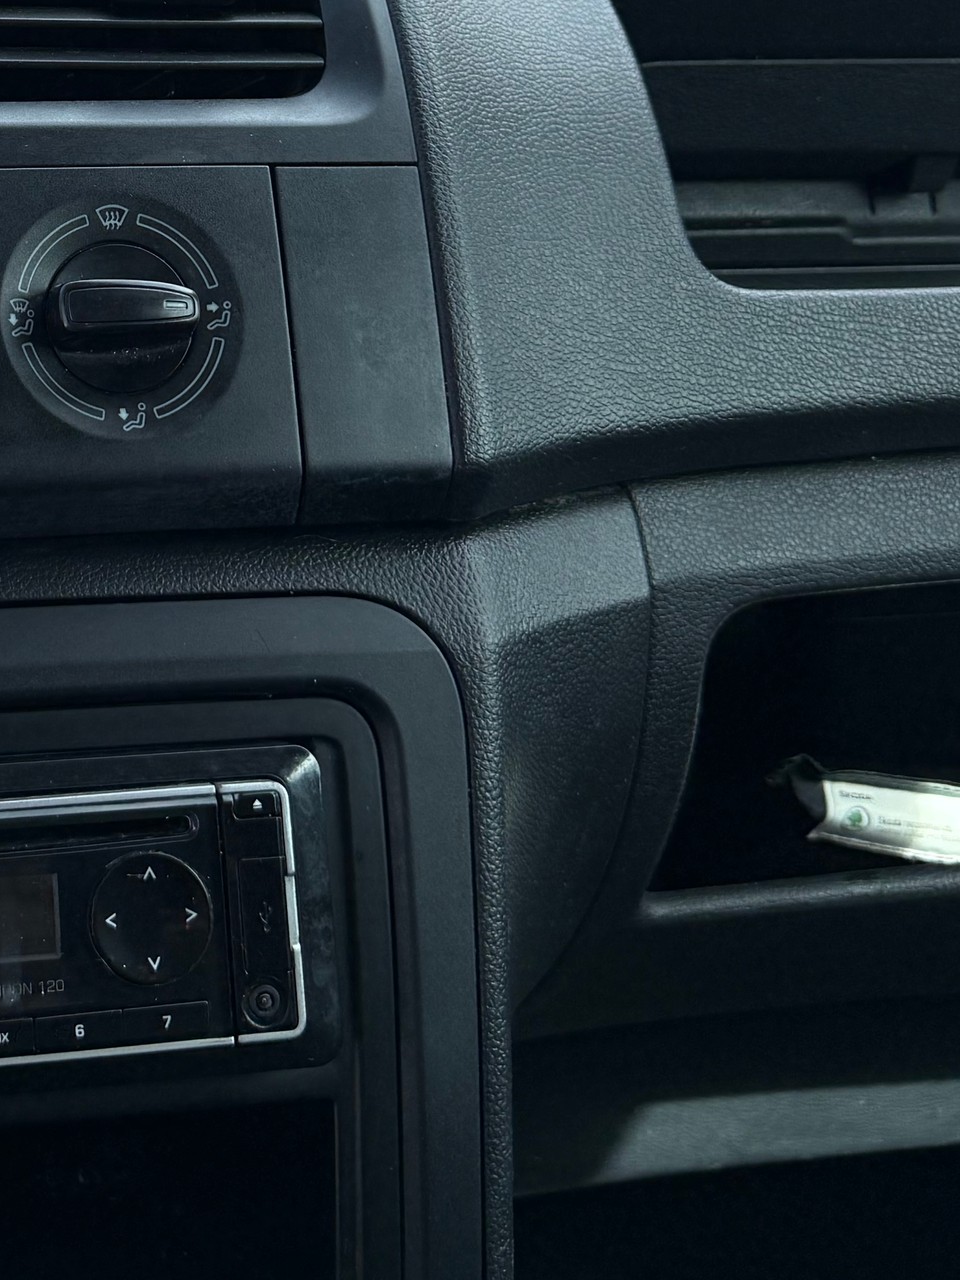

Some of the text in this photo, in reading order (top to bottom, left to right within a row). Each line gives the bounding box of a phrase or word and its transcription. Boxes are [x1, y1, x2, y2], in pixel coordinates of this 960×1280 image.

[38, 979, 65, 995] 120
[162, 1014, 172, 1029] 7
[74, 1023, 85, 1038] 6
